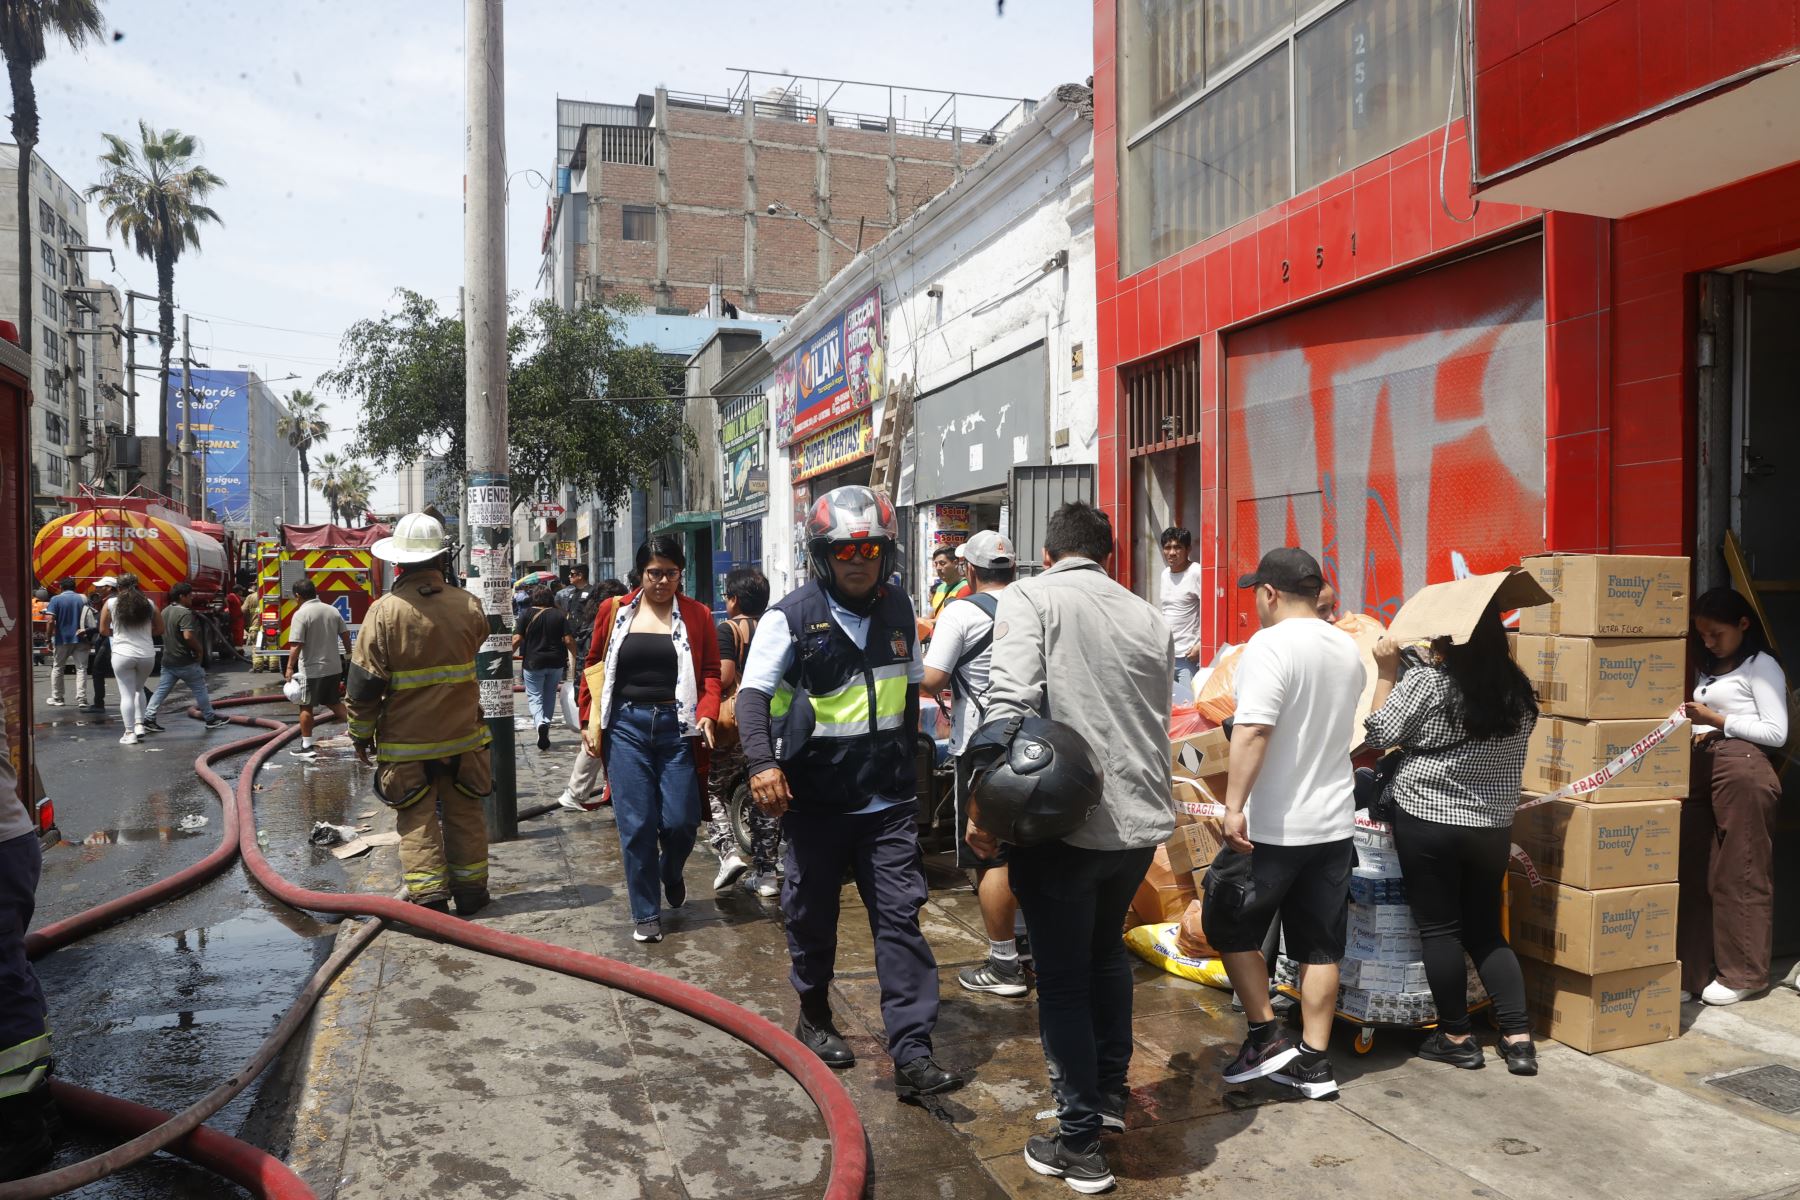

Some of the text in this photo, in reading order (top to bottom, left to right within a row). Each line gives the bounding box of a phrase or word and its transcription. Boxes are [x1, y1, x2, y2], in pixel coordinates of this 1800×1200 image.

[175, 385, 236, 398] ¿olor de
[176, 400, 220, 410] cello?
[468, 488, 477, 503] SE
[62, 525, 159, 539] BOMBEROS
[1608, 588, 1642, 599] Doctor
[1600, 670, 1634, 681] Doctor
[1631, 728, 1665, 759] FRAGIL
[1572, 767, 1613, 794] FRAGIL
[1187, 803, 1215, 815] FRAGIL
[1598, 838, 1631, 850] Doctor
[1601, 922, 1633, 935] Doctor
[1601, 1002, 1633, 1014] Doctor
